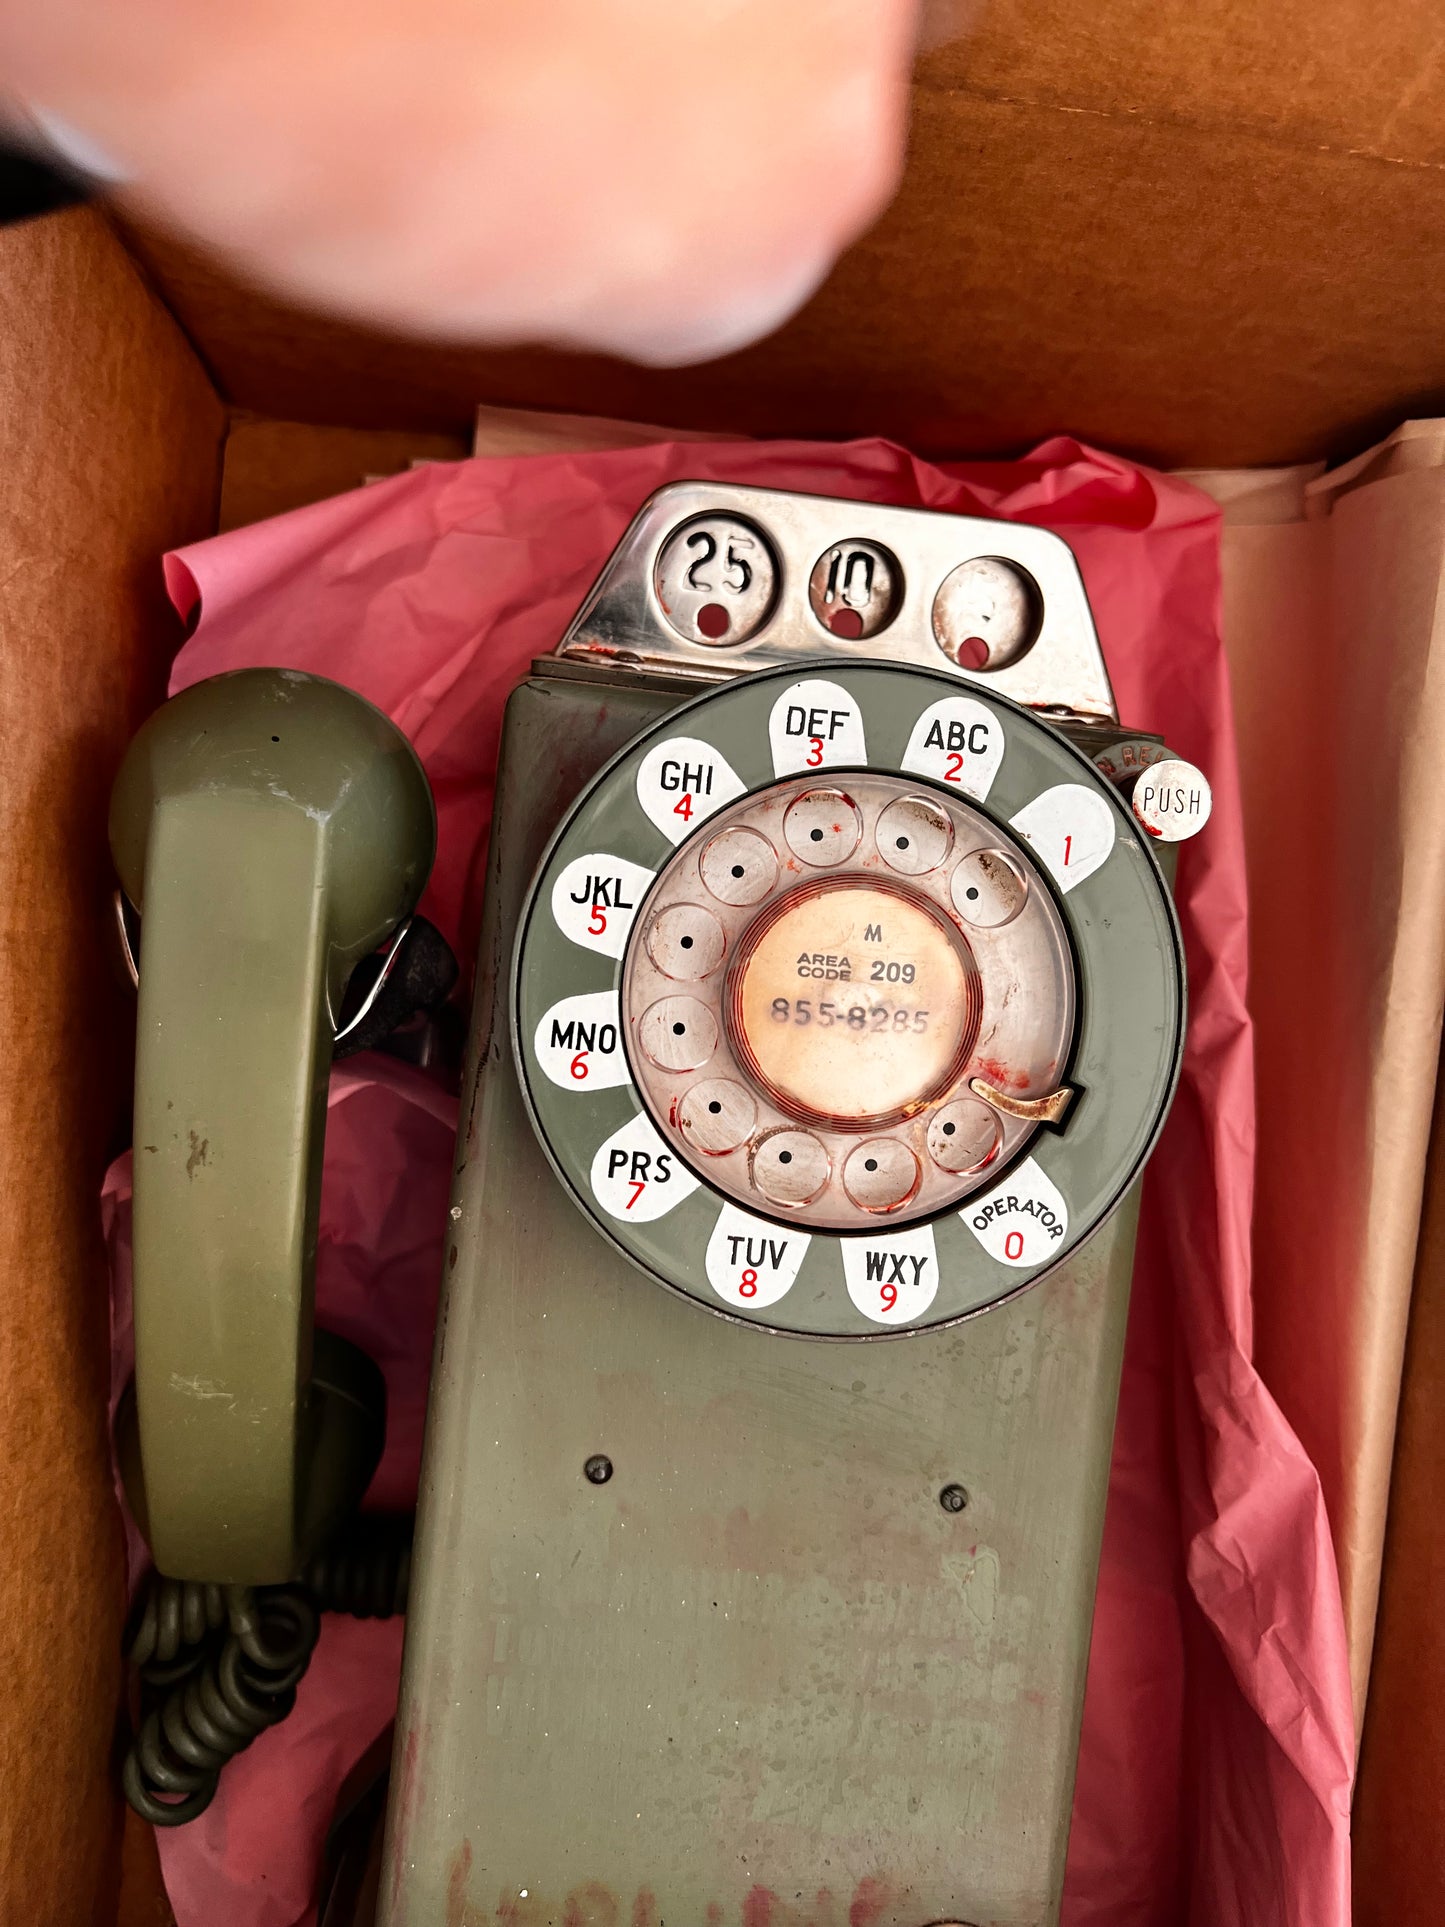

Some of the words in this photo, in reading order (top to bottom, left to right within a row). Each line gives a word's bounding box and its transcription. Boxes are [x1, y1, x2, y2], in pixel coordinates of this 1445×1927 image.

[687, 531, 755, 594] 25
[823, 549, 875, 607] 10
[785, 705, 850, 740] DEF
[923, 719, 989, 755] ABC
[805, 737, 824, 766] 3
[944, 752, 964, 782] 2
[660, 760, 713, 795] GHI
[673, 793, 694, 822] 4
[1143, 787, 1200, 814] PUSH
[1064, 835, 1072, 866] 1
[570, 875, 633, 909] JKL
[587, 904, 607, 935] 5
[864, 923, 882, 942] M
[796, 952, 852, 968] AREA
[797, 965, 852, 982] CODE
[870, 960, 916, 984] 209
[770, 997, 930, 1034] 855-8285
[550, 1019, 617, 1054] MNO
[570, 1051, 589, 1079] 6
[607, 1149, 672, 1183] PRS
[625, 1181, 646, 1210] 7
[972, 1195, 1064, 1240] OPERATOR
[727, 1235, 788, 1270] TUV
[1004, 1231, 1025, 1260] 0
[738, 1269, 758, 1298] 8
[866, 1251, 928, 1286] WXY
[880, 1283, 898, 1312] 9
